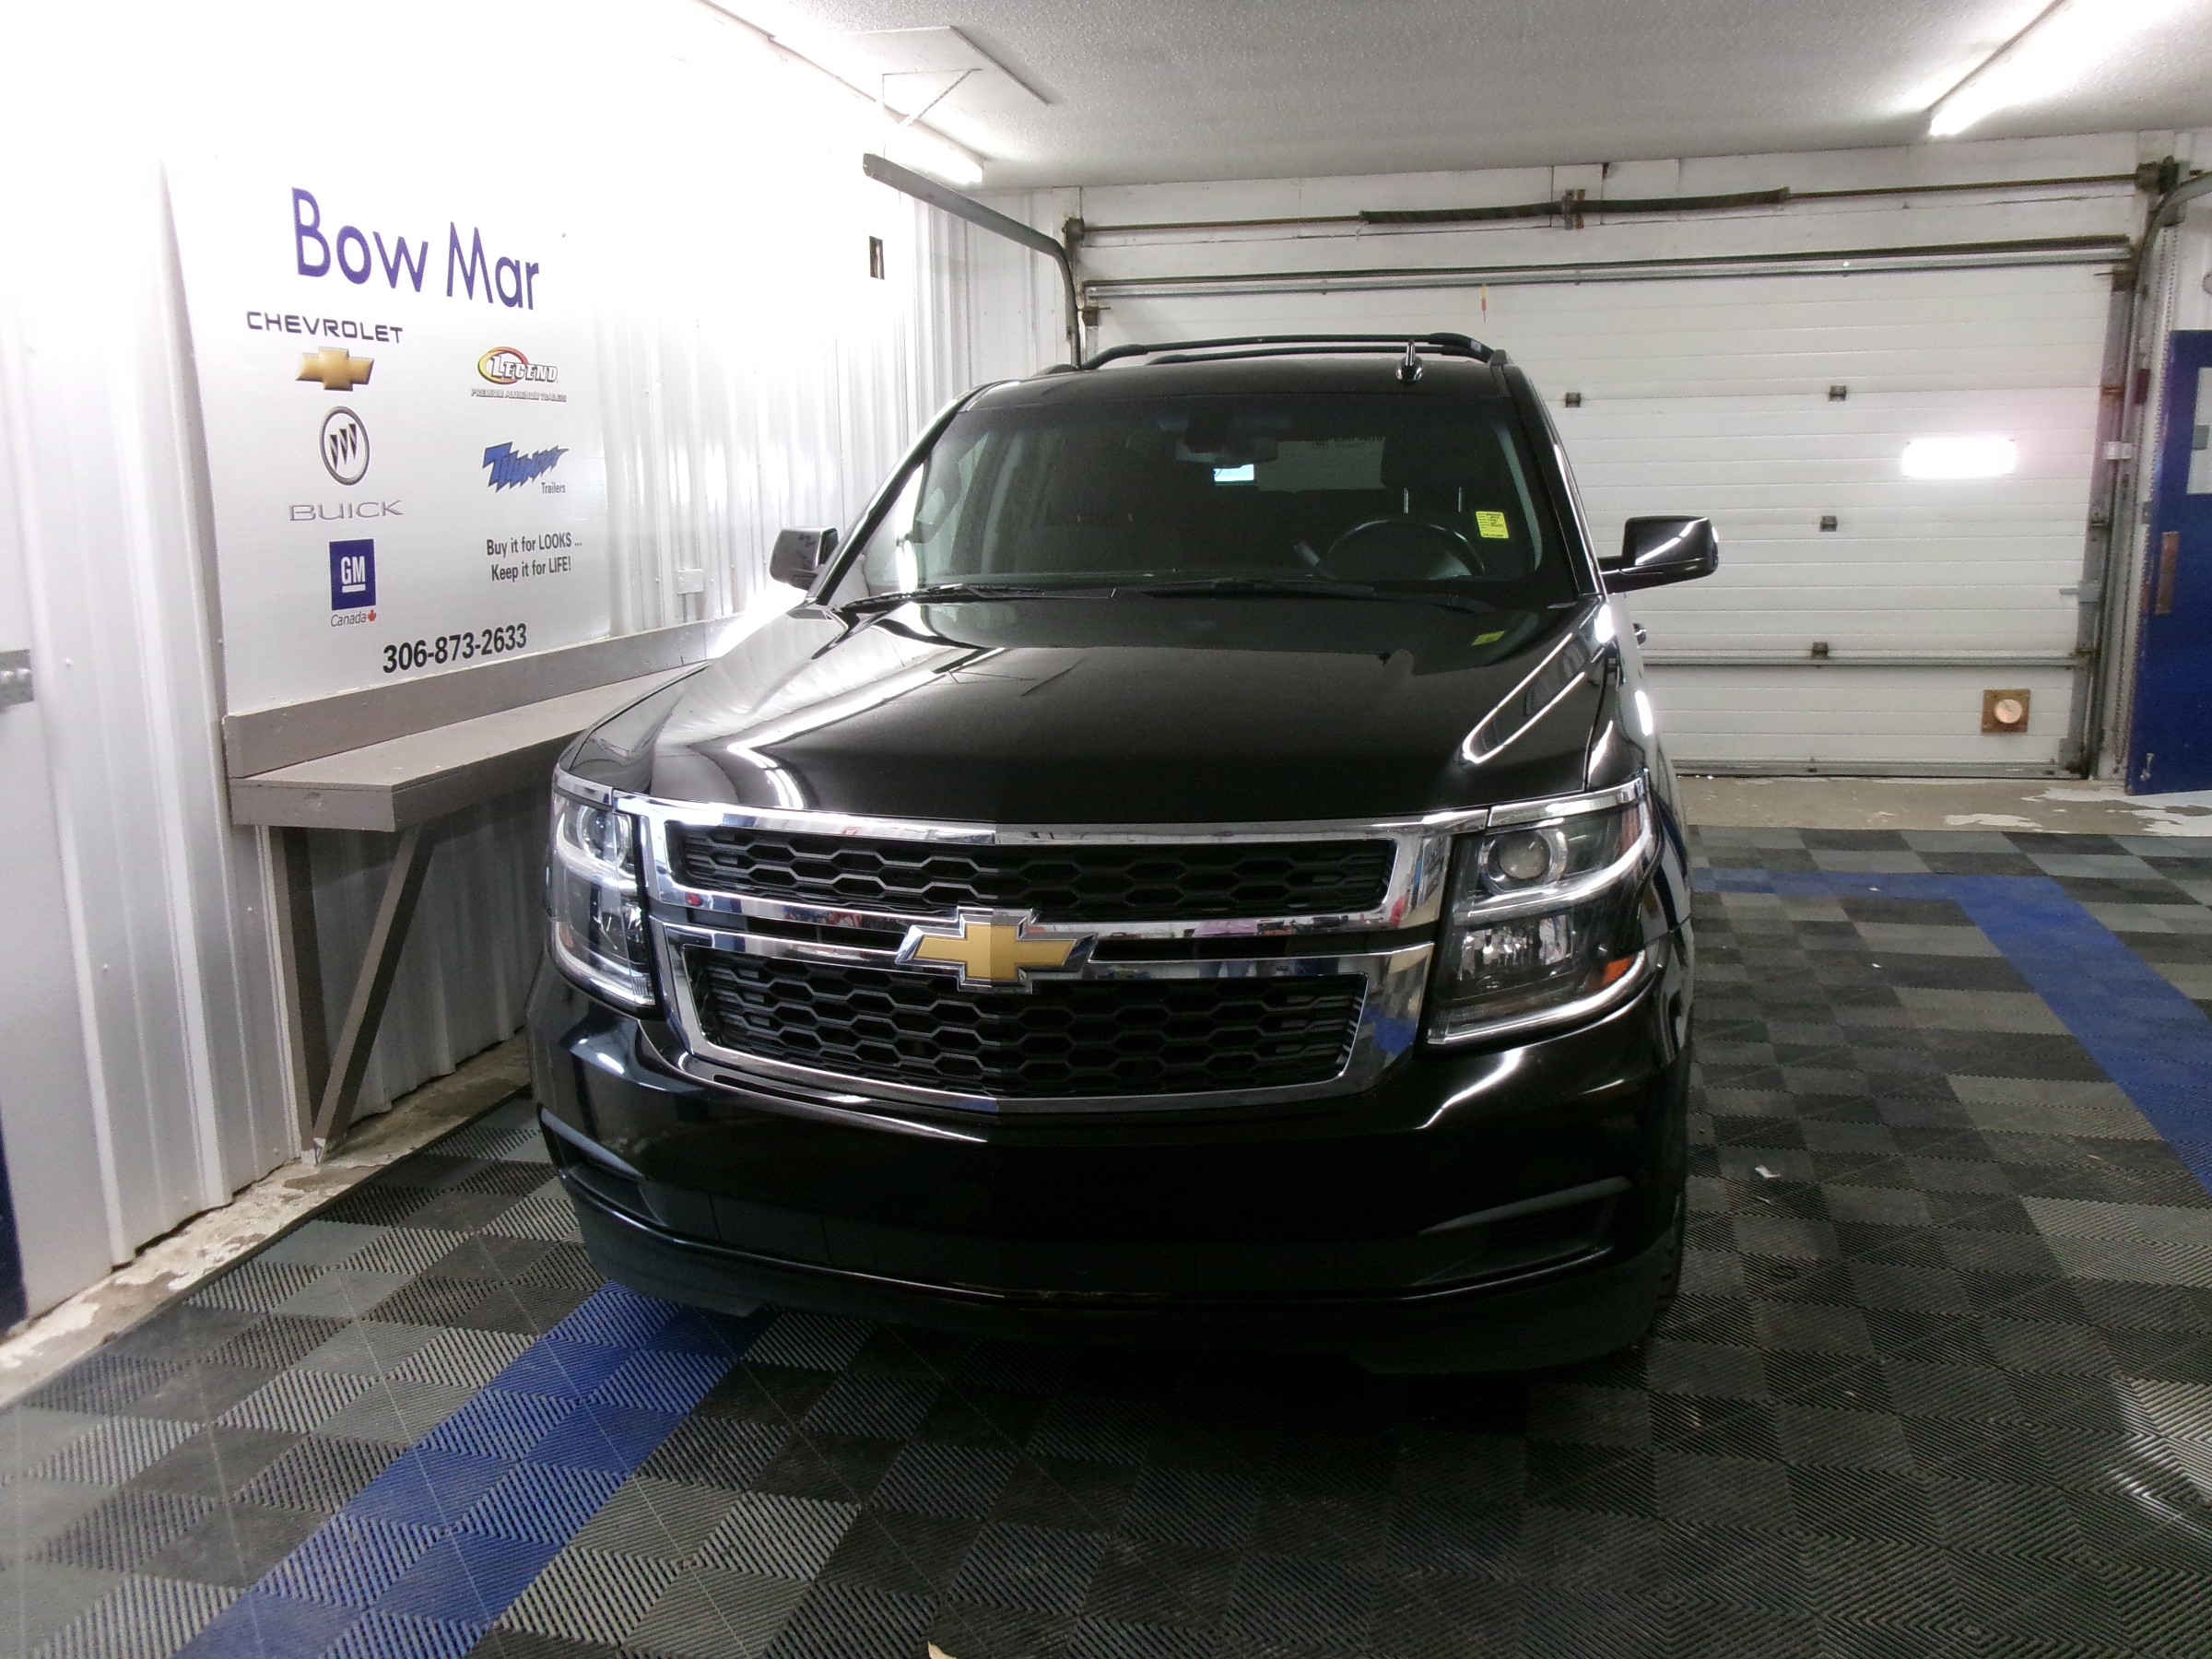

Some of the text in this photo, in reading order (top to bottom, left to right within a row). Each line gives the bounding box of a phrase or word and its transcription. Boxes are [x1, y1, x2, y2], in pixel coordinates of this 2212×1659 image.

[291, 186, 540, 310] Bow Mar
[245, 311, 404, 344] CHEVROLET
[490, 355, 559, 383] LEGEND
[541, 481, 566, 495] Trailers
[289, 500, 405, 522] BUICK
[486, 538, 508, 559] Buy
[511, 536, 519, 554] it
[521, 535, 536, 552] for
[538, 532, 572, 550] LOOKS
[340, 555, 366, 585] GM
[491, 555, 571, 582] Keep it for LIFE!
[330, 611, 367, 628] Canada
[382, 622, 528, 674] 306-873-2633
